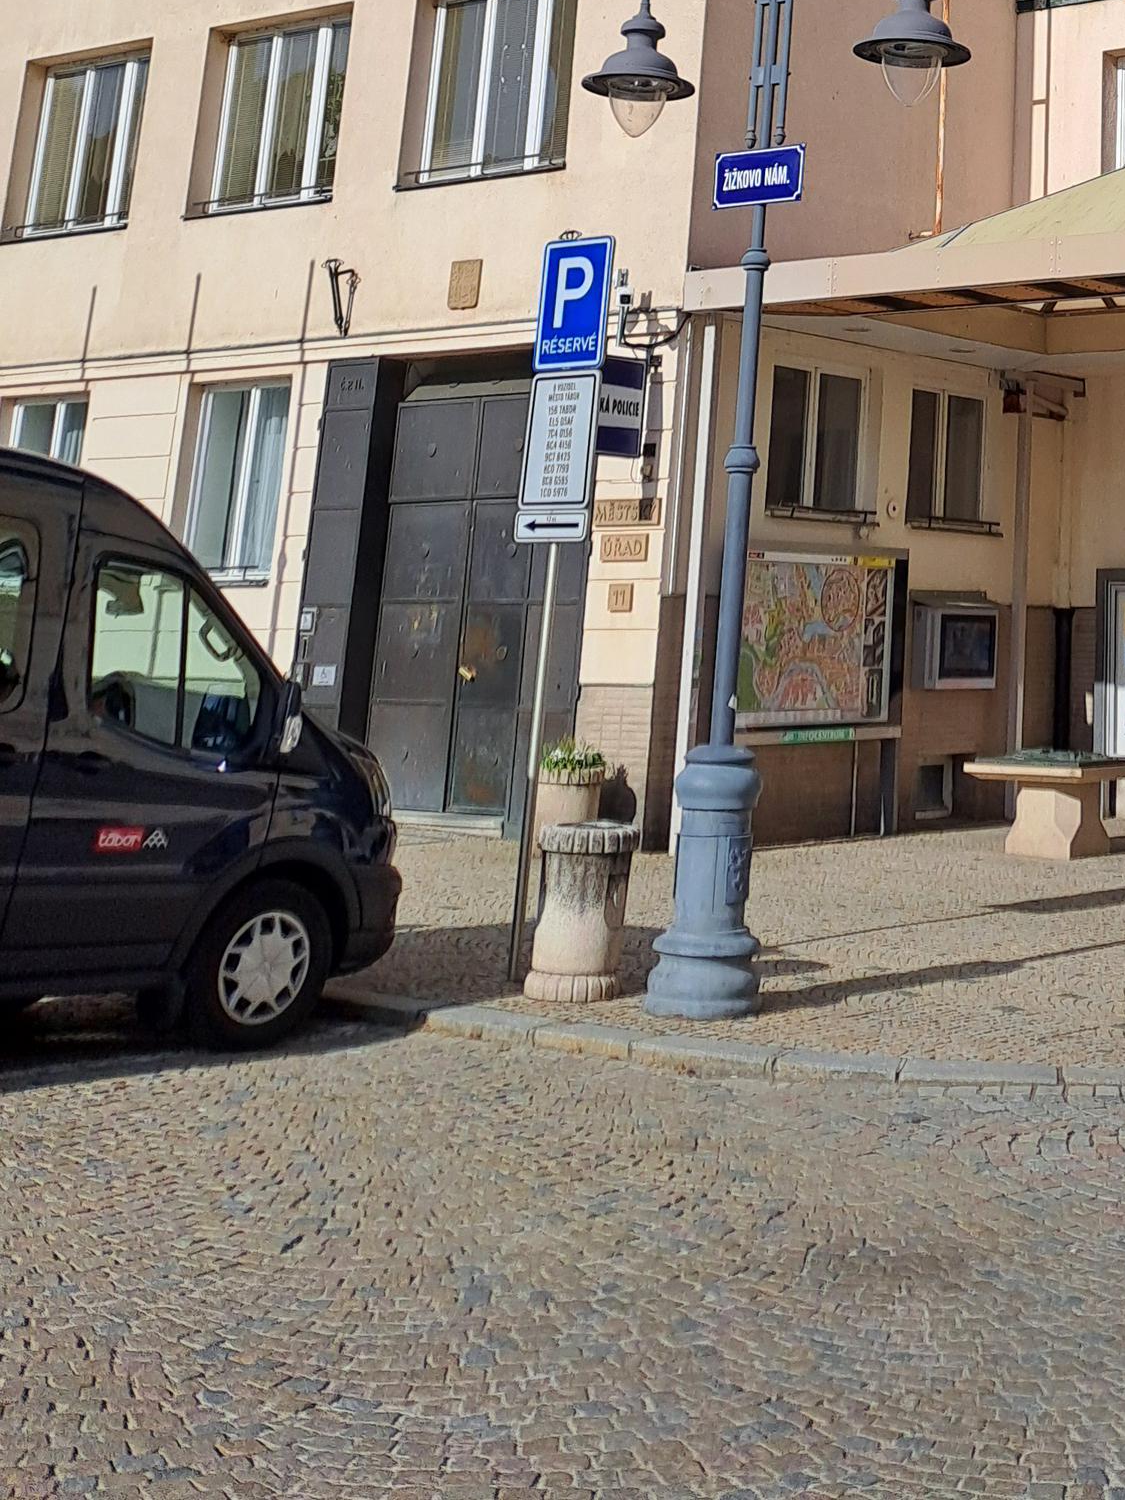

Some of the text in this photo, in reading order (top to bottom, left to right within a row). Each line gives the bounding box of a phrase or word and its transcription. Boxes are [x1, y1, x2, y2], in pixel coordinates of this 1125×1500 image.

[722, 162, 790, 191] ŽIŽKOVO NÁM.
[553, 256, 594, 329] P
[541, 331, 597, 355] RÉSERVÉ
[611, 398, 640, 417] POLICIE
[603, 538, 643, 557] ÚŘAD
